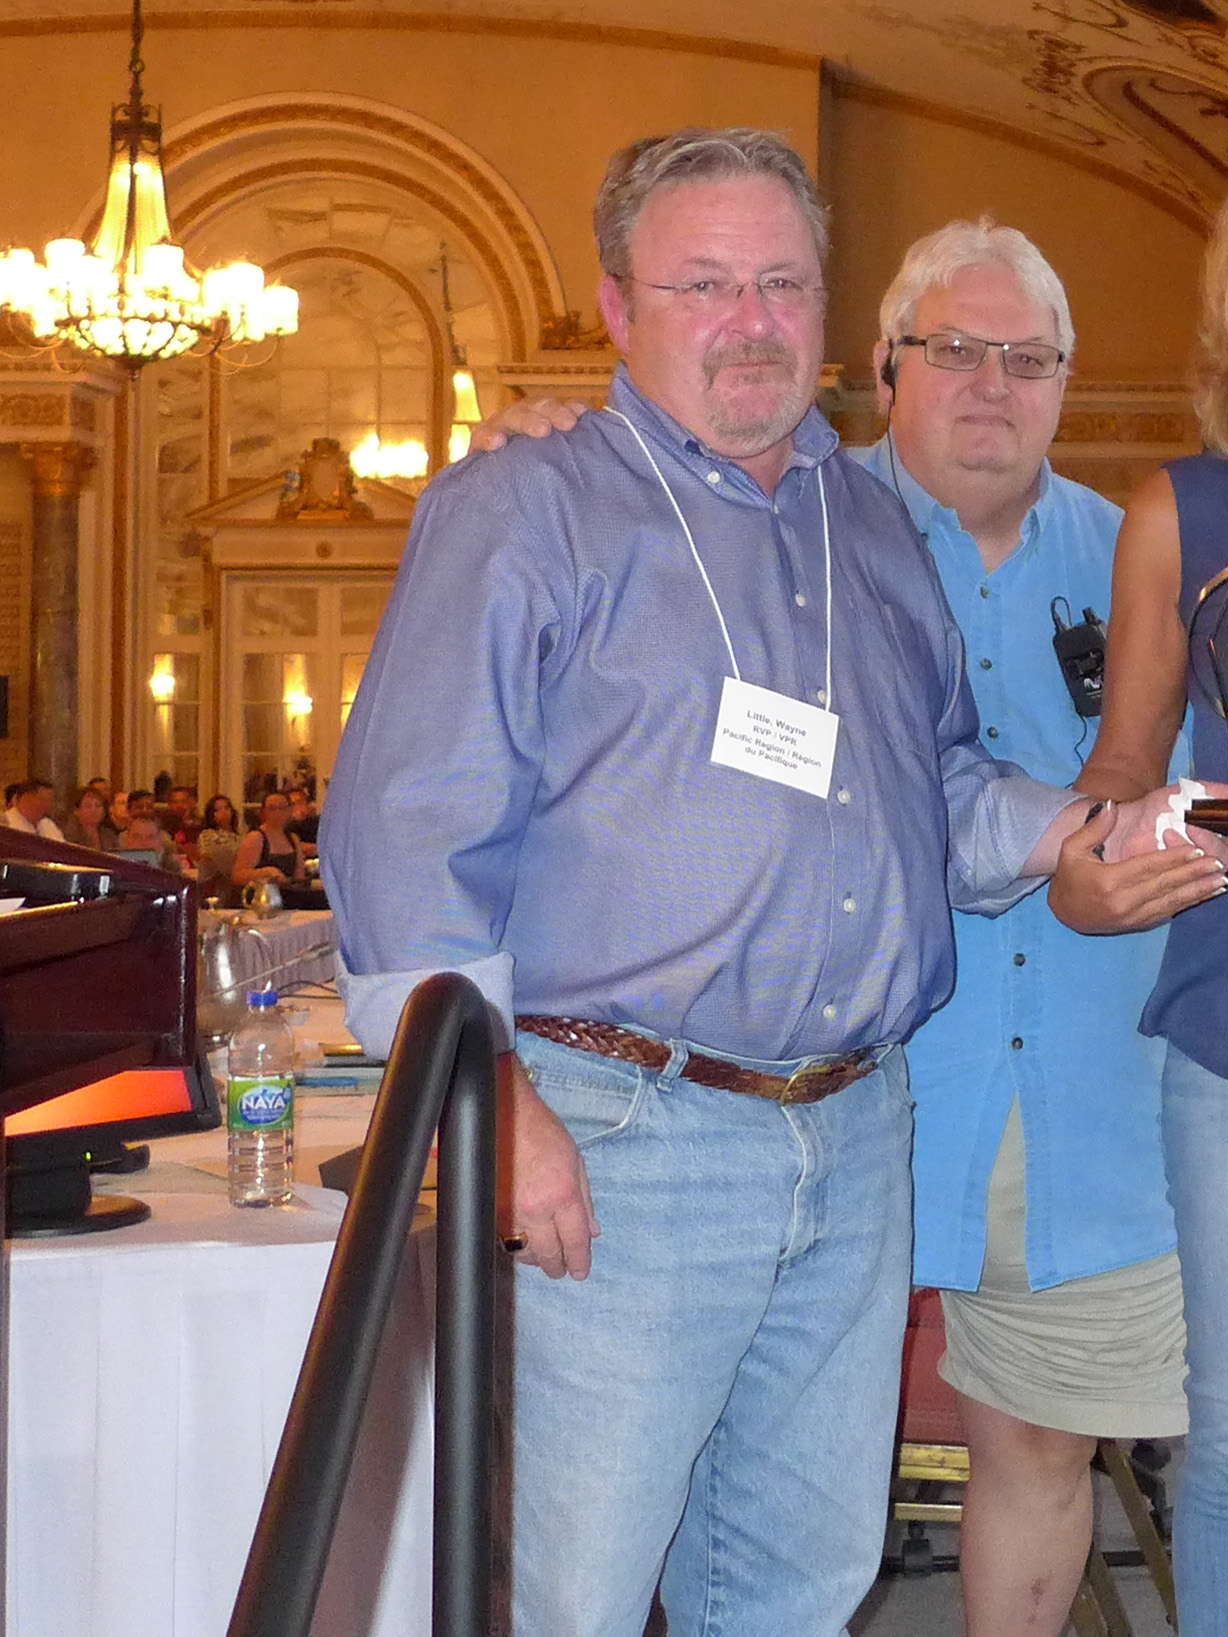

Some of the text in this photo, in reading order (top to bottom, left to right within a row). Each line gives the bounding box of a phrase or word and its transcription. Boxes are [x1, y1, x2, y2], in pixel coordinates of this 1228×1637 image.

[746, 710, 807, 737] Little, Wayne
[722, 727, 753, 744] Pacific
[755, 738, 785, 754] Region
[753, 725, 772, 736] RVP
[779, 733, 797, 746] VPR
[744, 746, 798, 769] du Pacifique
[242, 1094, 285, 1110] NAYA
